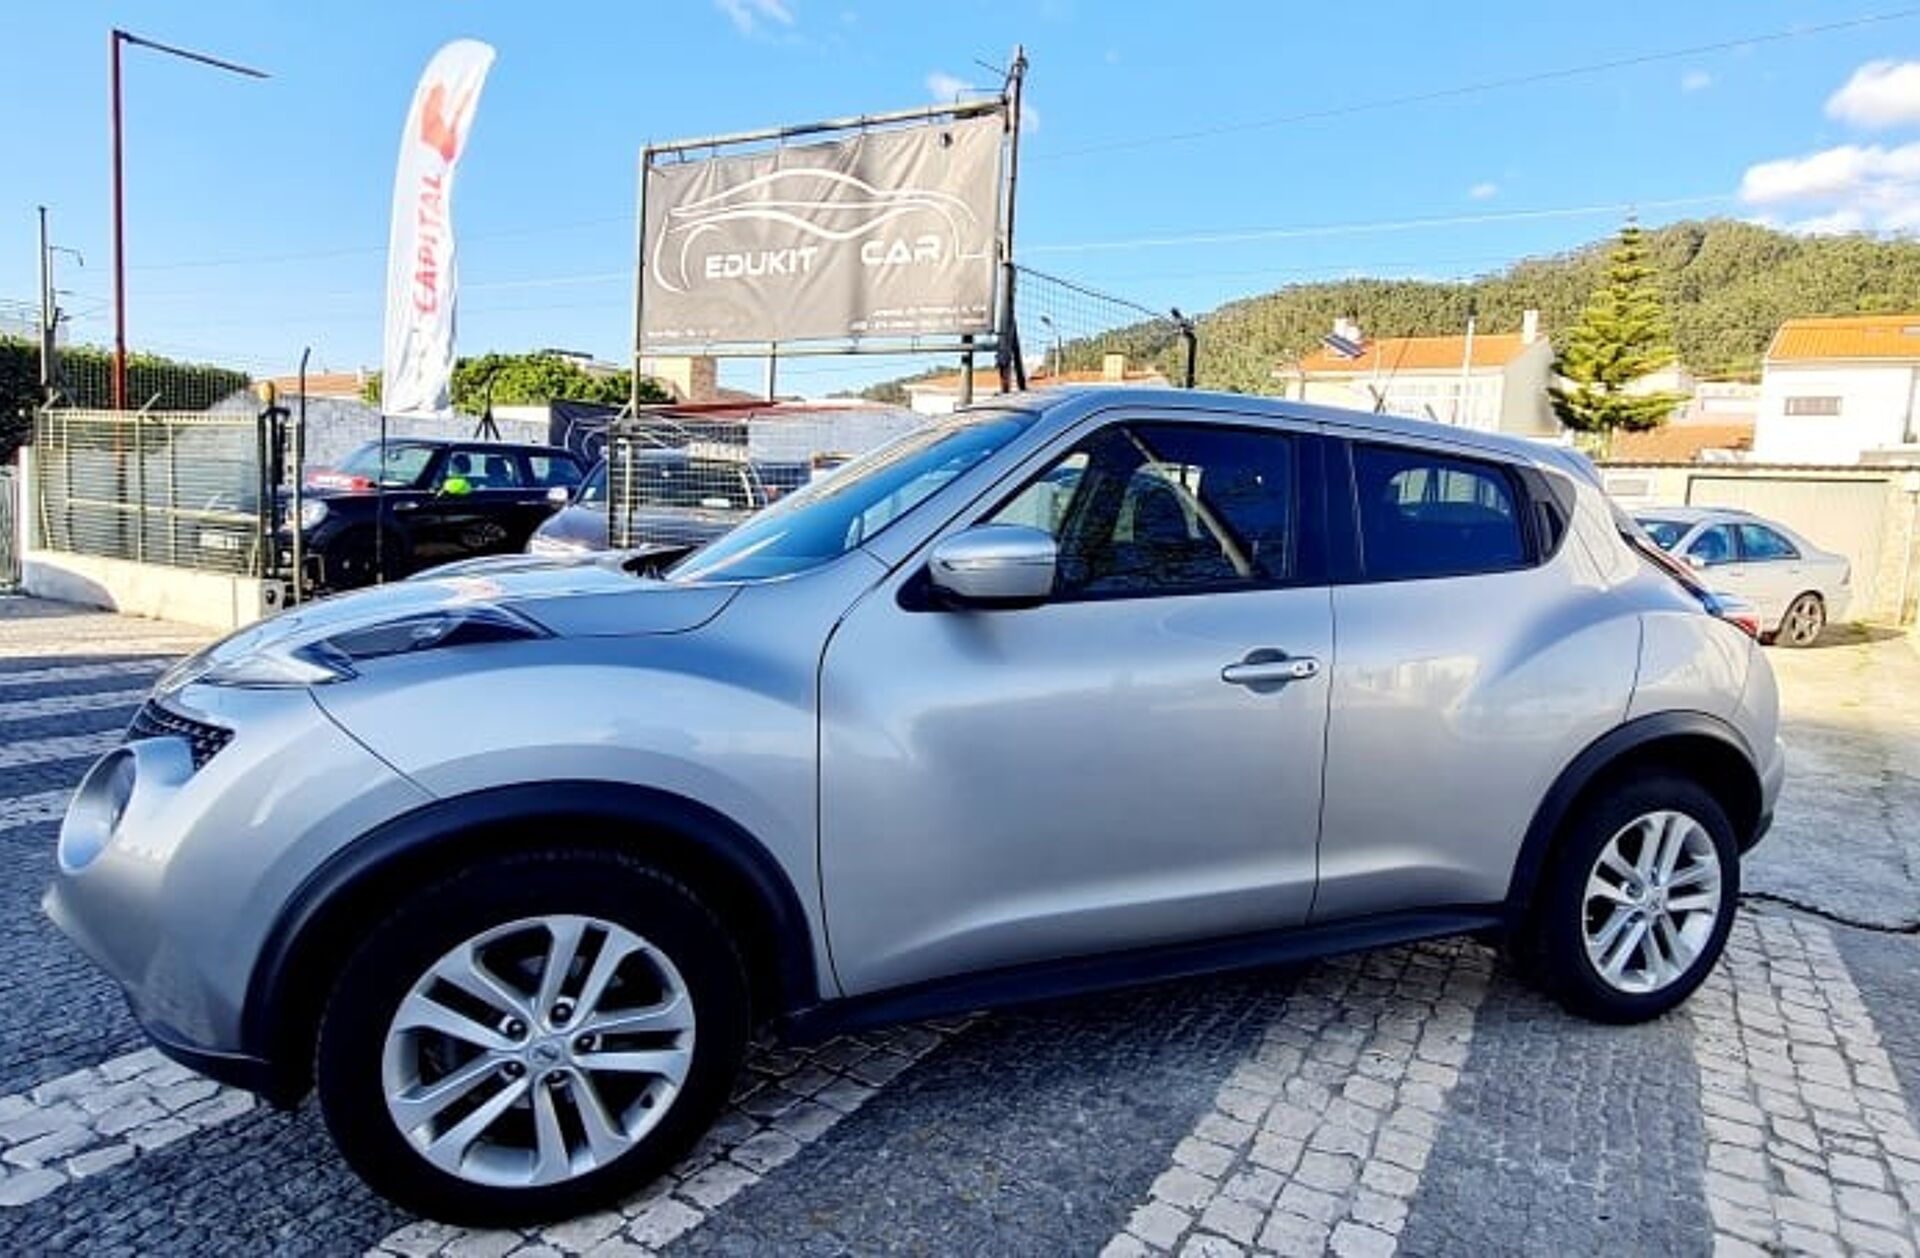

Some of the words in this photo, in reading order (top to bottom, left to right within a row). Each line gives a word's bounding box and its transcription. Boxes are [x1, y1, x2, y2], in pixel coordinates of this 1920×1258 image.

[413, 174, 443, 314] CAPITAL
[705, 247, 818, 279] EDUKIT
[860, 234, 941, 266] CAR
